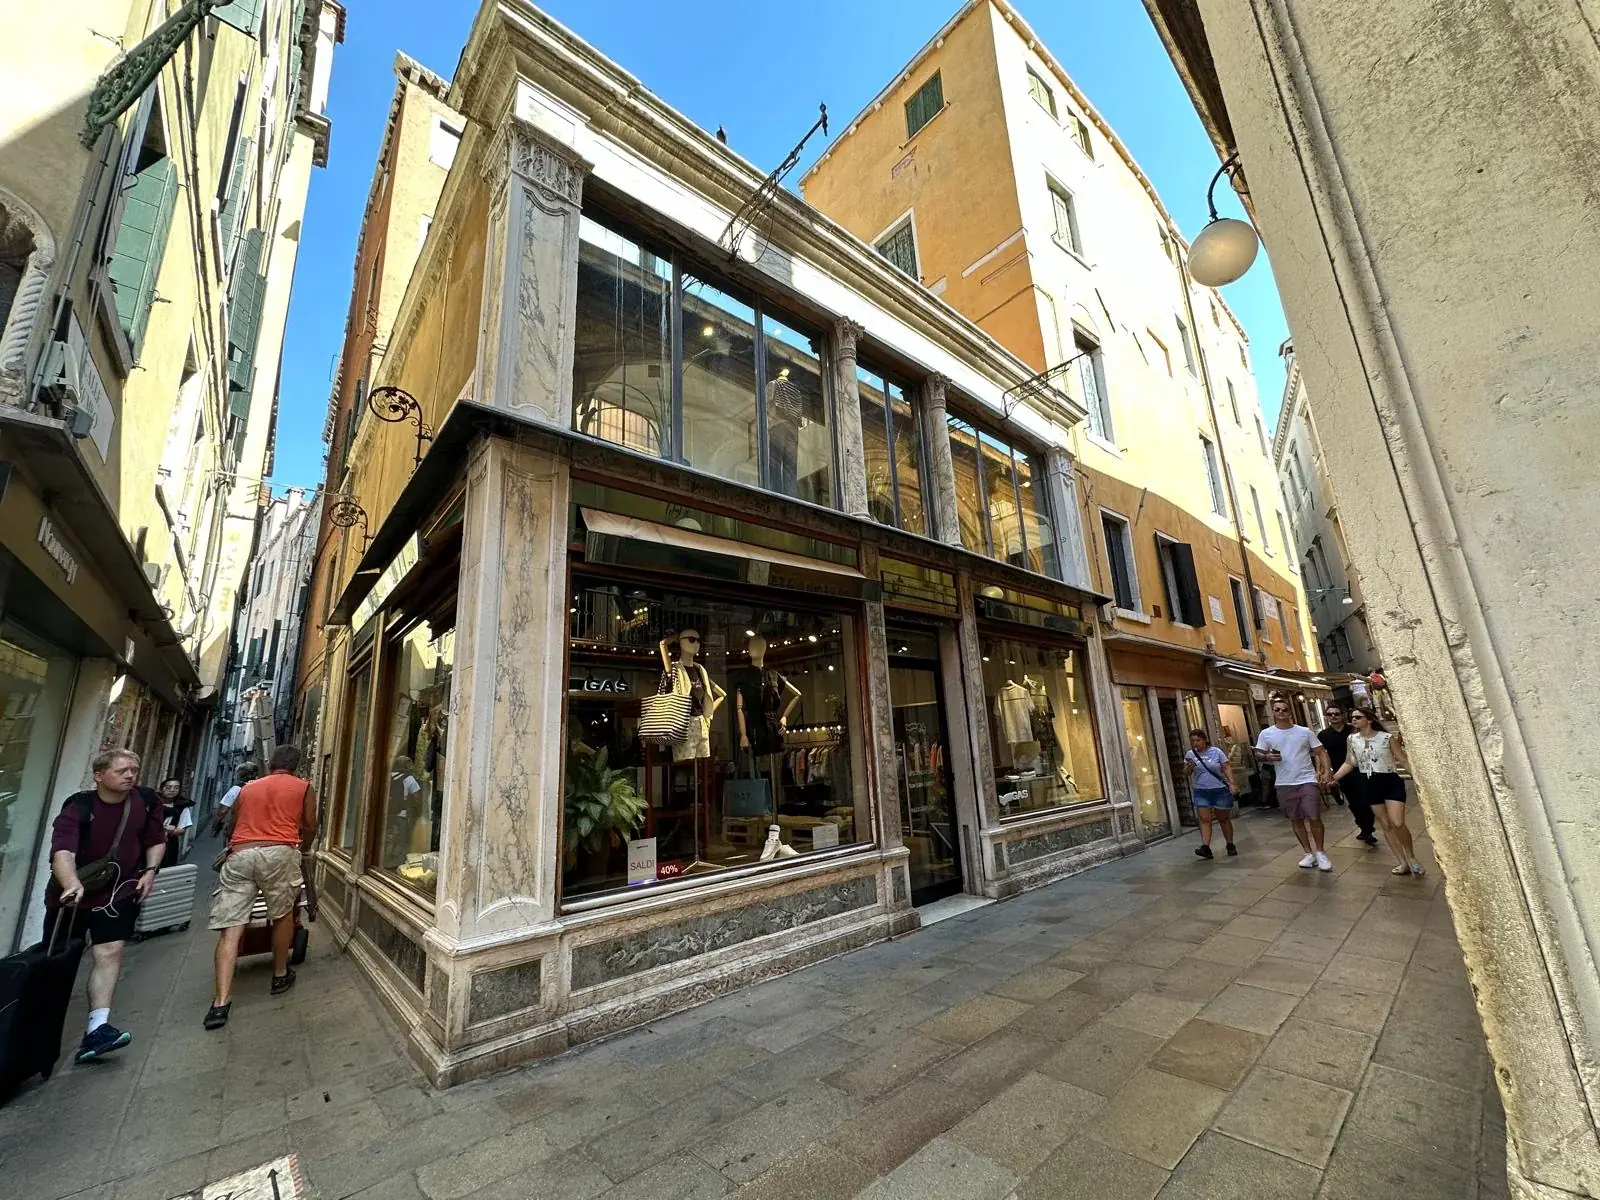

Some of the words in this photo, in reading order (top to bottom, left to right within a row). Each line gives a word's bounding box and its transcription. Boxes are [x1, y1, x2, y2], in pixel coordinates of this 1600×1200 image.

[584, 679, 630, 693] GAS
[1011, 789, 1029, 801] GAS
[630, 859, 655, 871] SALDI
[660, 864, 679, 875] 40%
